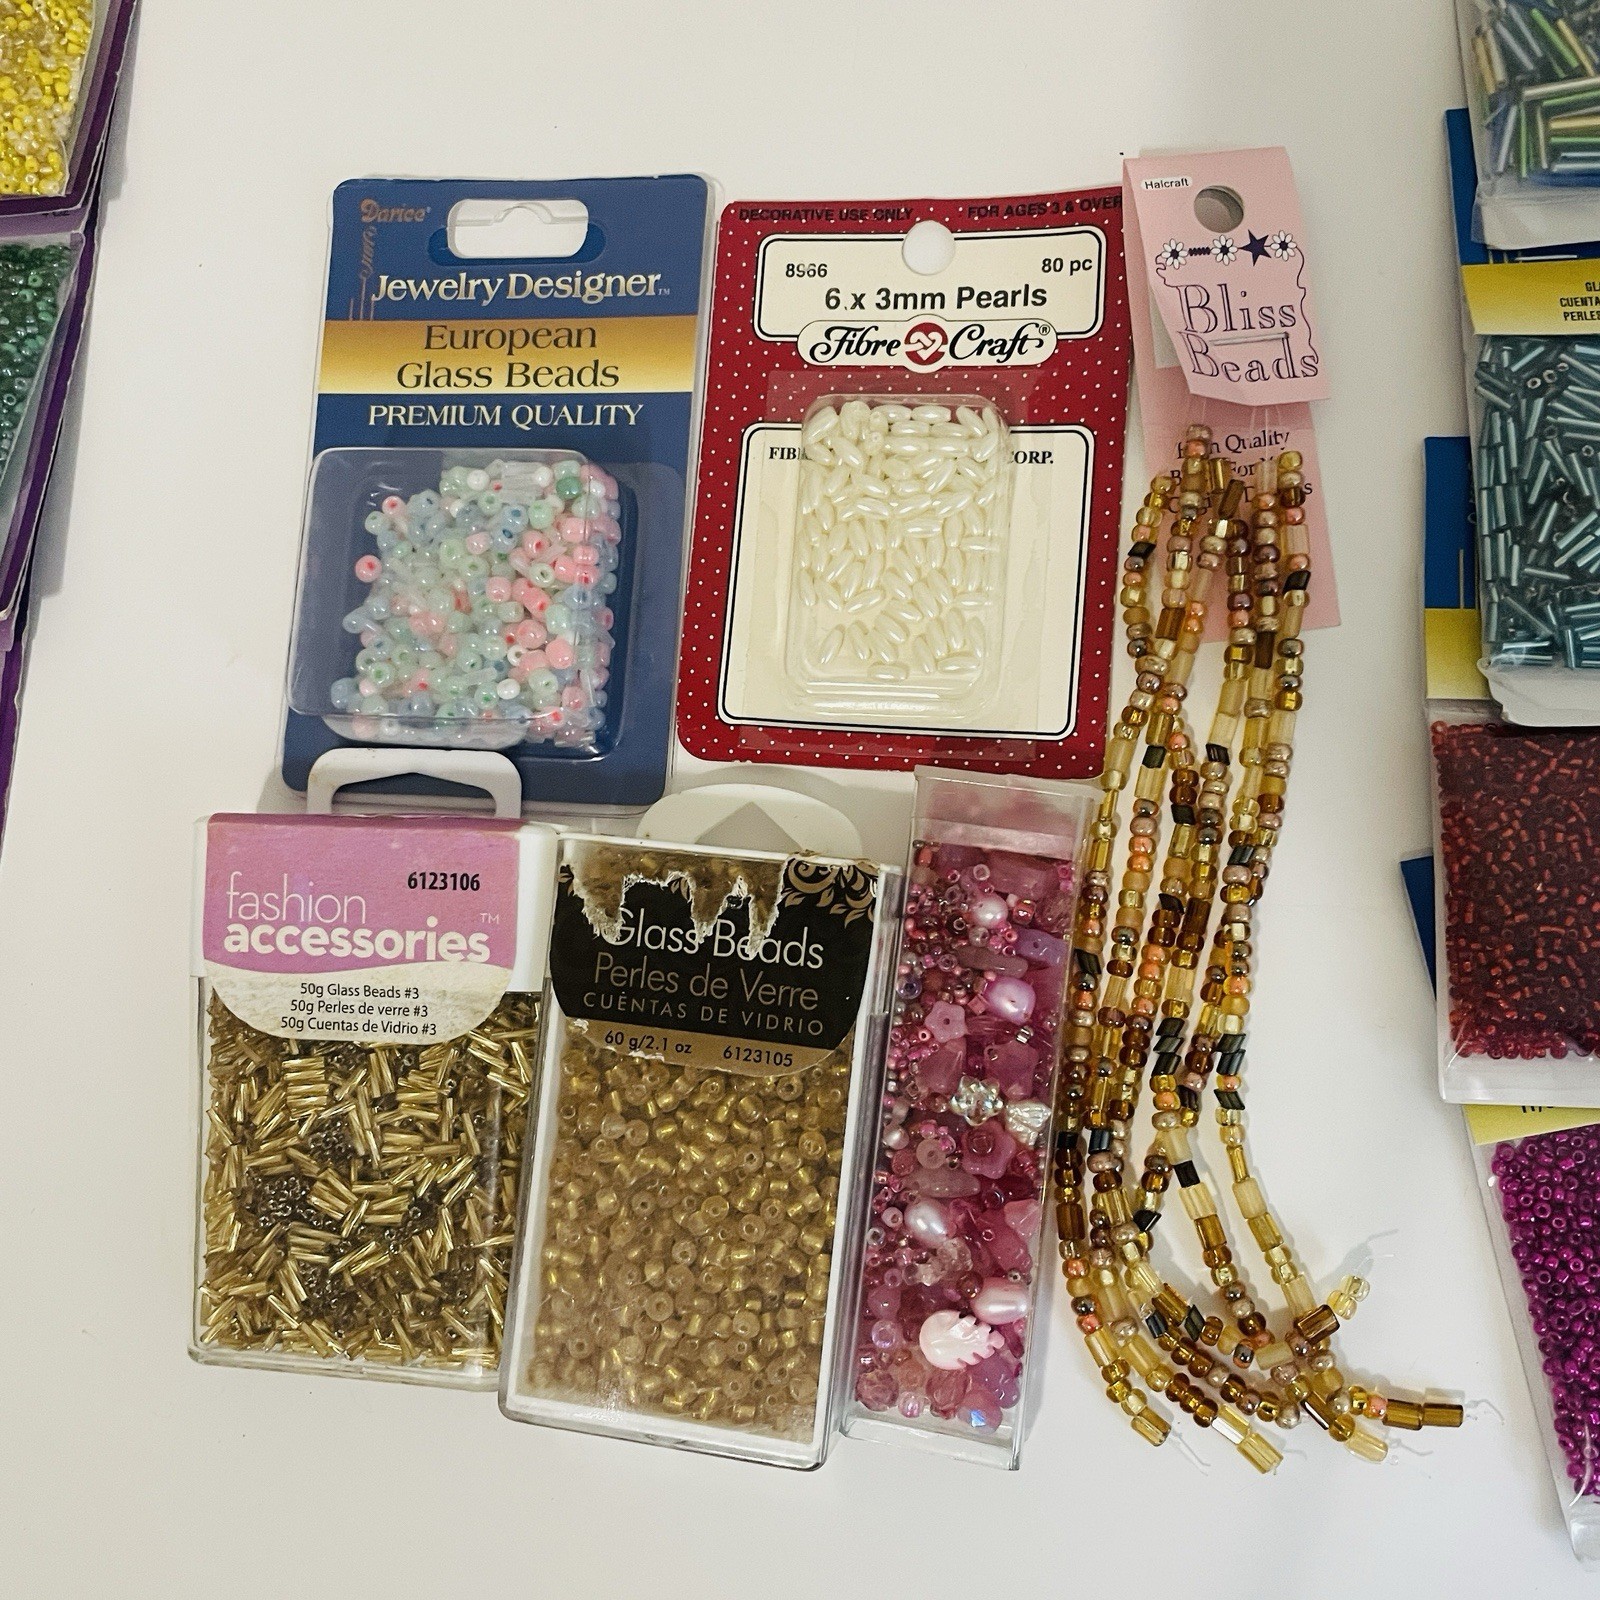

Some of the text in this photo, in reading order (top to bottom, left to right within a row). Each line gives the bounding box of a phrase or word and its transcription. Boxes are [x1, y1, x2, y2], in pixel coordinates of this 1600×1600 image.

[1145, 178, 1189, 189] Halcraft
[739, 207, 913, 221] DECORATIVE USE ONLY
[968, 205, 999, 218] FOR
[1003, 203, 1047, 216] AGES
[1052, 201, 1059, 214] 3
[1041, 257, 1093, 276] 80 pc
[372, 273, 503, 306] Jewelry
[508, 270, 662, 304] Designer
[875, 287, 946, 310] 3mm
[956, 284, 1048, 309] Pearls
[1585, 281, 1600, 292] GL
[1176, 283, 1297, 334] Bliss
[424, 324, 597, 356] European
[809, 325, 901, 363] Fibre
[949, 322, 1044, 363] Craft
[1177, 330, 1319, 383] Beads
[397, 359, 620, 389] Glass Beads
[368, 403, 644, 430] PREMIUM QUALITY
[1225, 430, 1289, 453] Quality
[1008, 450, 1054, 464] ORP.
[407, 871, 480, 892] 6123106
[226, 871, 366, 924] fashion
[223, 916, 491, 962] accessories
[601, 907, 824, 969] Glass Beads
[300, 982, 419, 999] 50g Glass Beads #3
[594, 951, 819, 1012] Perles de Verre
[290, 1000, 429, 1018] 50g Perles de verre #3
[701, 1006, 728, 1024] DE
[742, 1010, 824, 1036] VIDRIO
[281, 1017, 437, 1036] 50g Cuentas de Vidrio #3
[604, 1030, 693, 1055] 60 g/2.1 oz
[723, 1045, 793, 1068] 6123105
